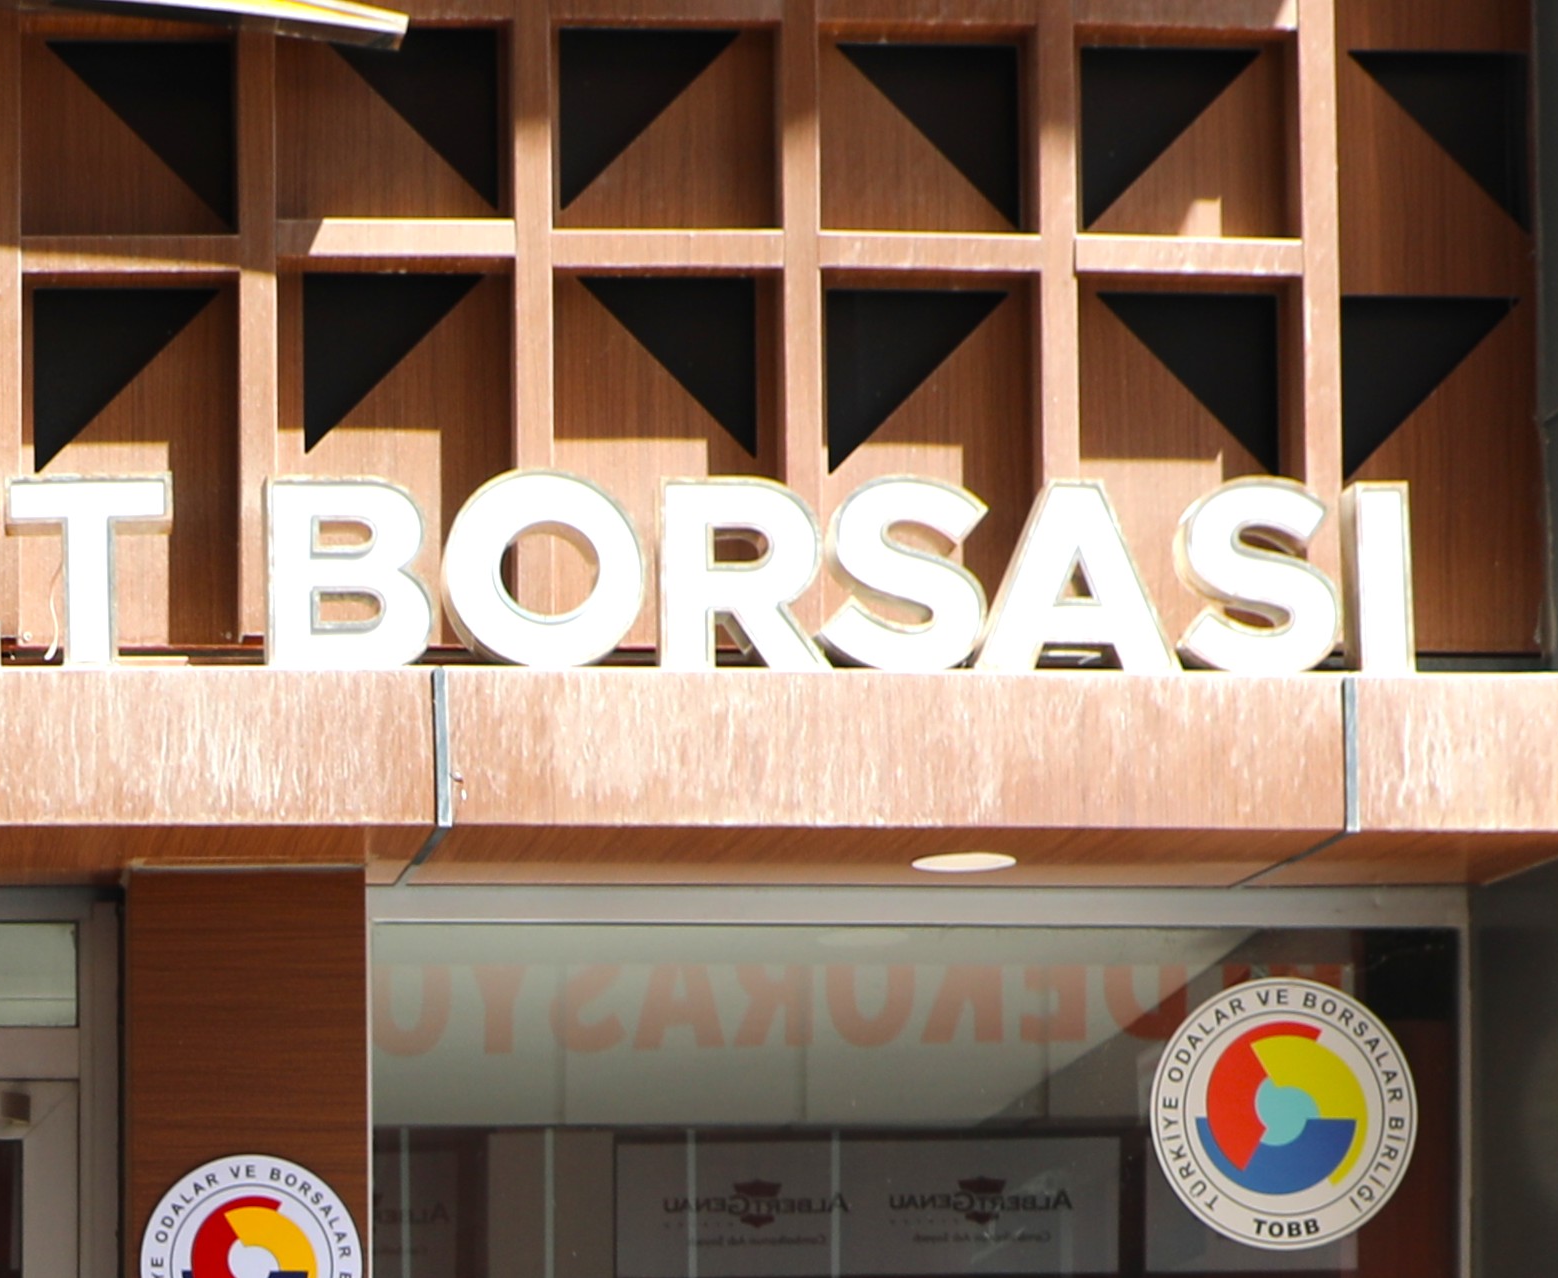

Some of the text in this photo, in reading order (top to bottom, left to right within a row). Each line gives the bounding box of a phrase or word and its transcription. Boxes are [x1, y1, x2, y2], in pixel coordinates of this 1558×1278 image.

[266, 467, 1417, 671] BORSASI
[1162, 989, 1404, 1212] TÜRKİYE ODALAR VE BORSALAR BİRLİĞİ
[154, 1173, 220, 1243] ODALAR
[229, 1165, 256, 1179] VE
[270, 1168, 352, 1258] BORSALAR
[1253, 1219, 1320, 1238] TOBB
